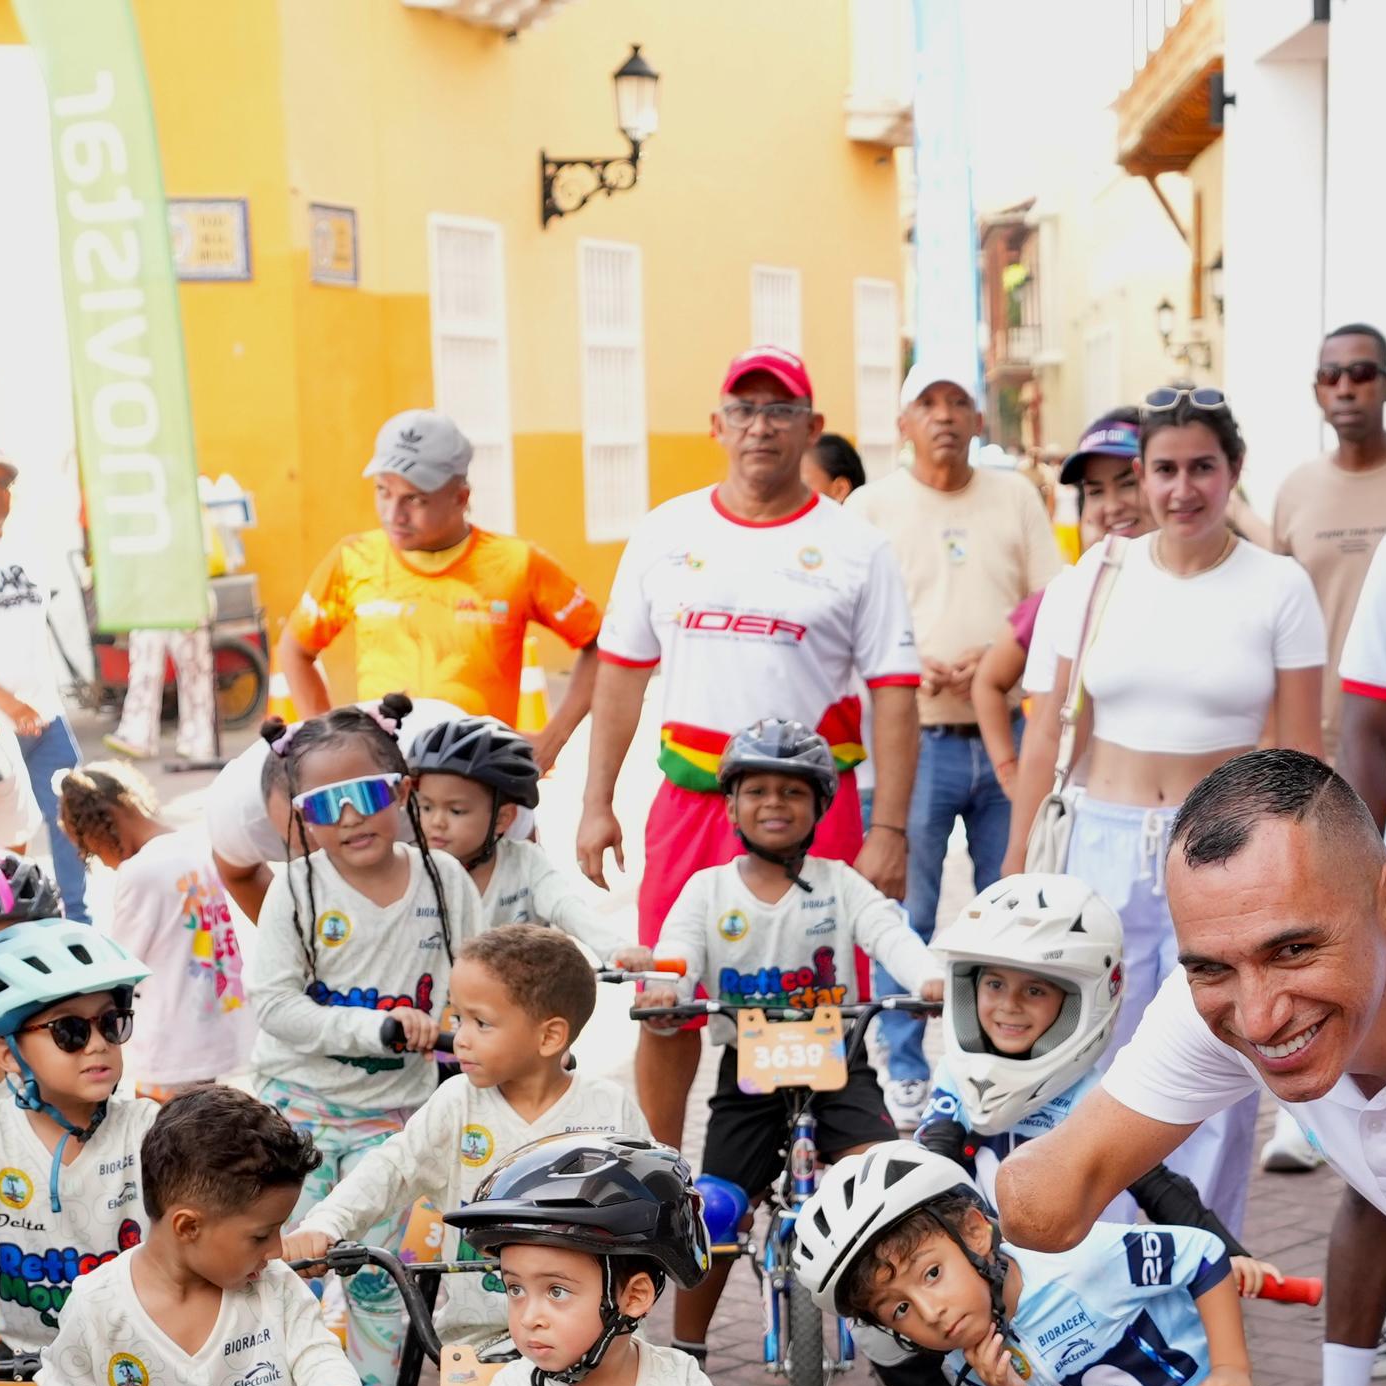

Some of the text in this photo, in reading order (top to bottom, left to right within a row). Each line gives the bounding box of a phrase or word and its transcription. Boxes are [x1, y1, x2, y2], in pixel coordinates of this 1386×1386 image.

[682, 610, 807, 642] IDER
[719, 966, 814, 995] Retico
[1141, 1232, 1162, 1285] 25
[1037, 1312, 1086, 1347] BIORACER
[1054, 1340, 1095, 1373] Electrolit
